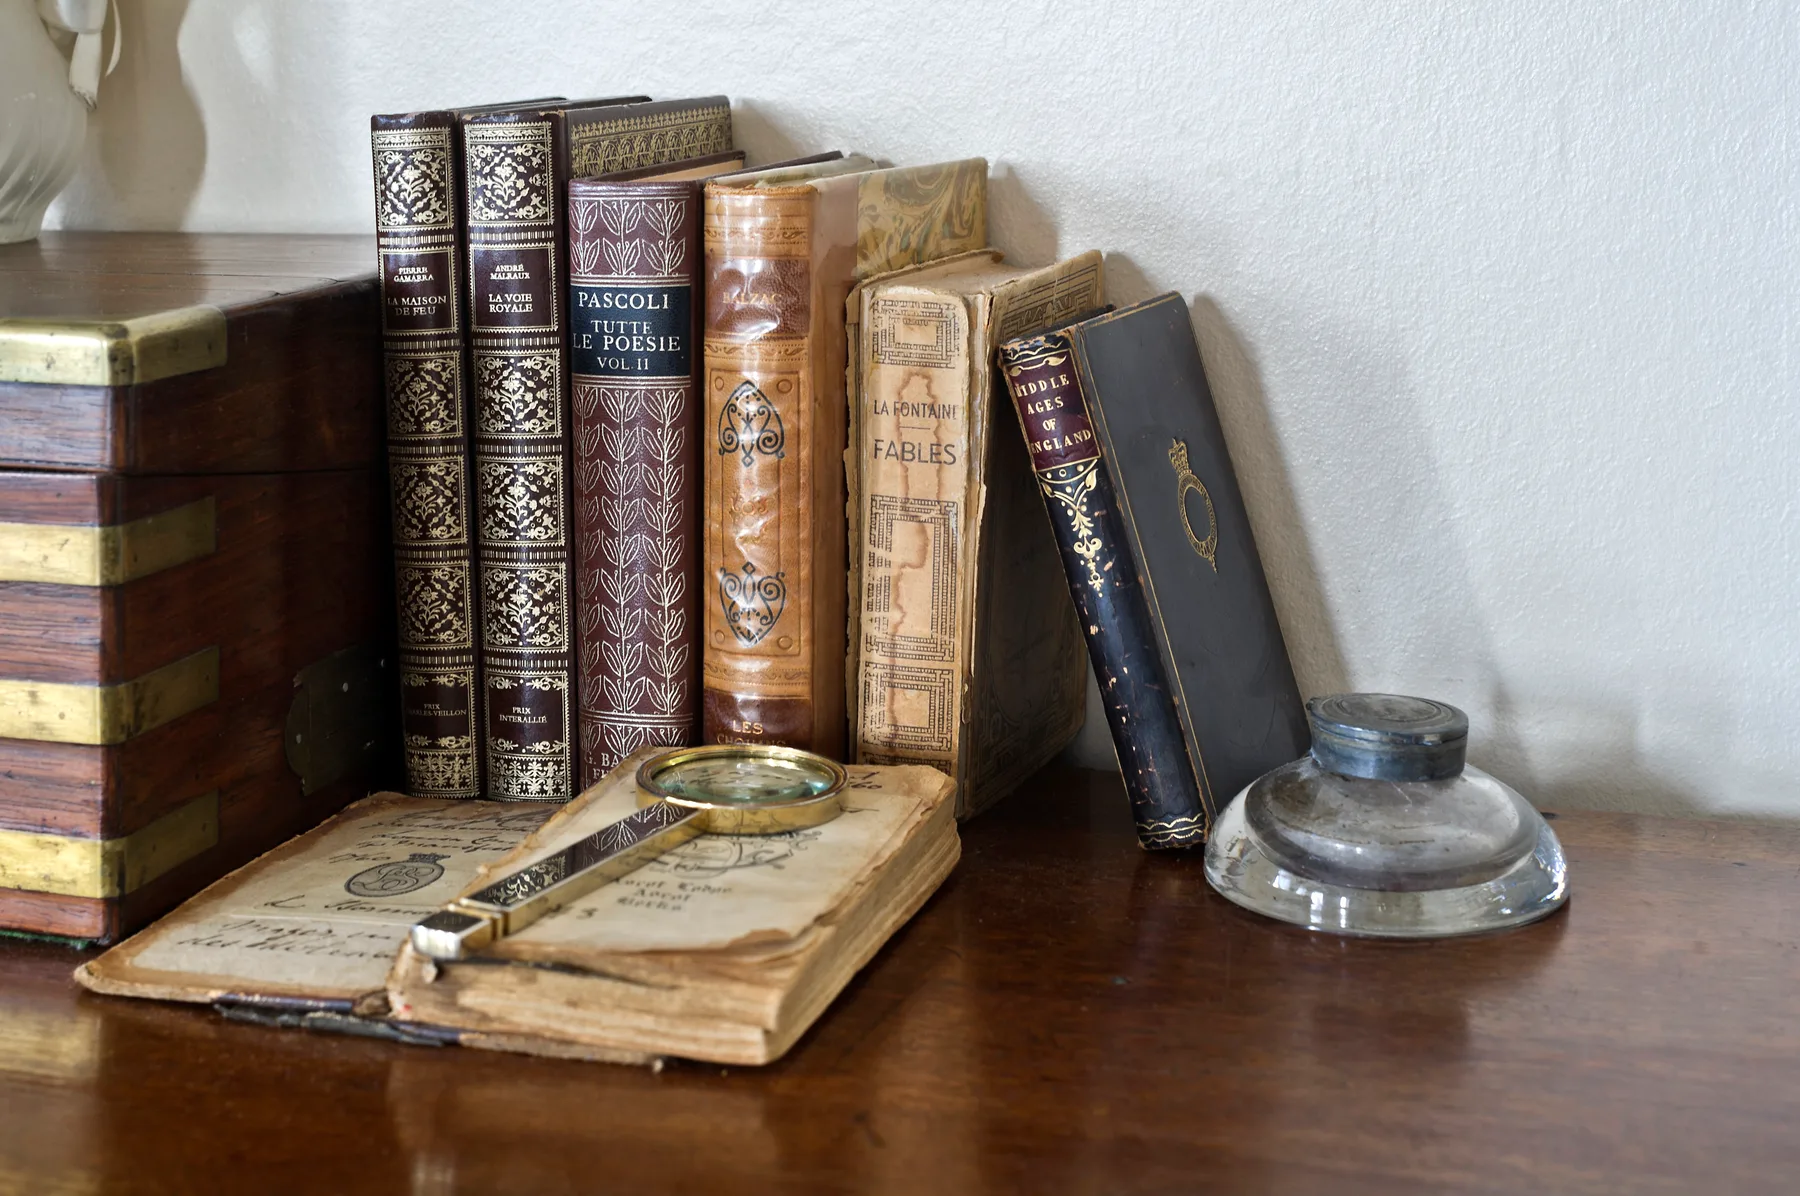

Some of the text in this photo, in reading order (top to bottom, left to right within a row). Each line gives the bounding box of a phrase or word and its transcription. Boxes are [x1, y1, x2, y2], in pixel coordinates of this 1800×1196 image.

[399, 266, 428, 276] PIERRE
[495, 263, 525, 272] ANDRÉ
[394, 273, 434, 283] GAMARRA
[490, 272, 531, 280] MALRAUX
[388, 295, 447, 306] LA MAISON
[489, 293, 533, 303] LA VOIE
[578, 291, 669, 310] PASCOLI
[722, 292, 782, 305] BALZAC
[395, 306, 436, 317] DE FEU
[489, 303, 533, 313] ROYALE
[590, 320, 653, 334] TUTTE
[573, 332, 681, 352] LE POESIE
[597, 357, 649, 371] VOL. II
[873, 400, 889, 416] LA
[1027, 396, 1064, 415] AGES
[1042, 418, 1056, 431] OF
[873, 439, 957, 466] FABLES
[512, 706, 531, 714] PRIX
[499, 714, 548, 724] INTERALLIÉ
[732, 719, 764, 735] LES
